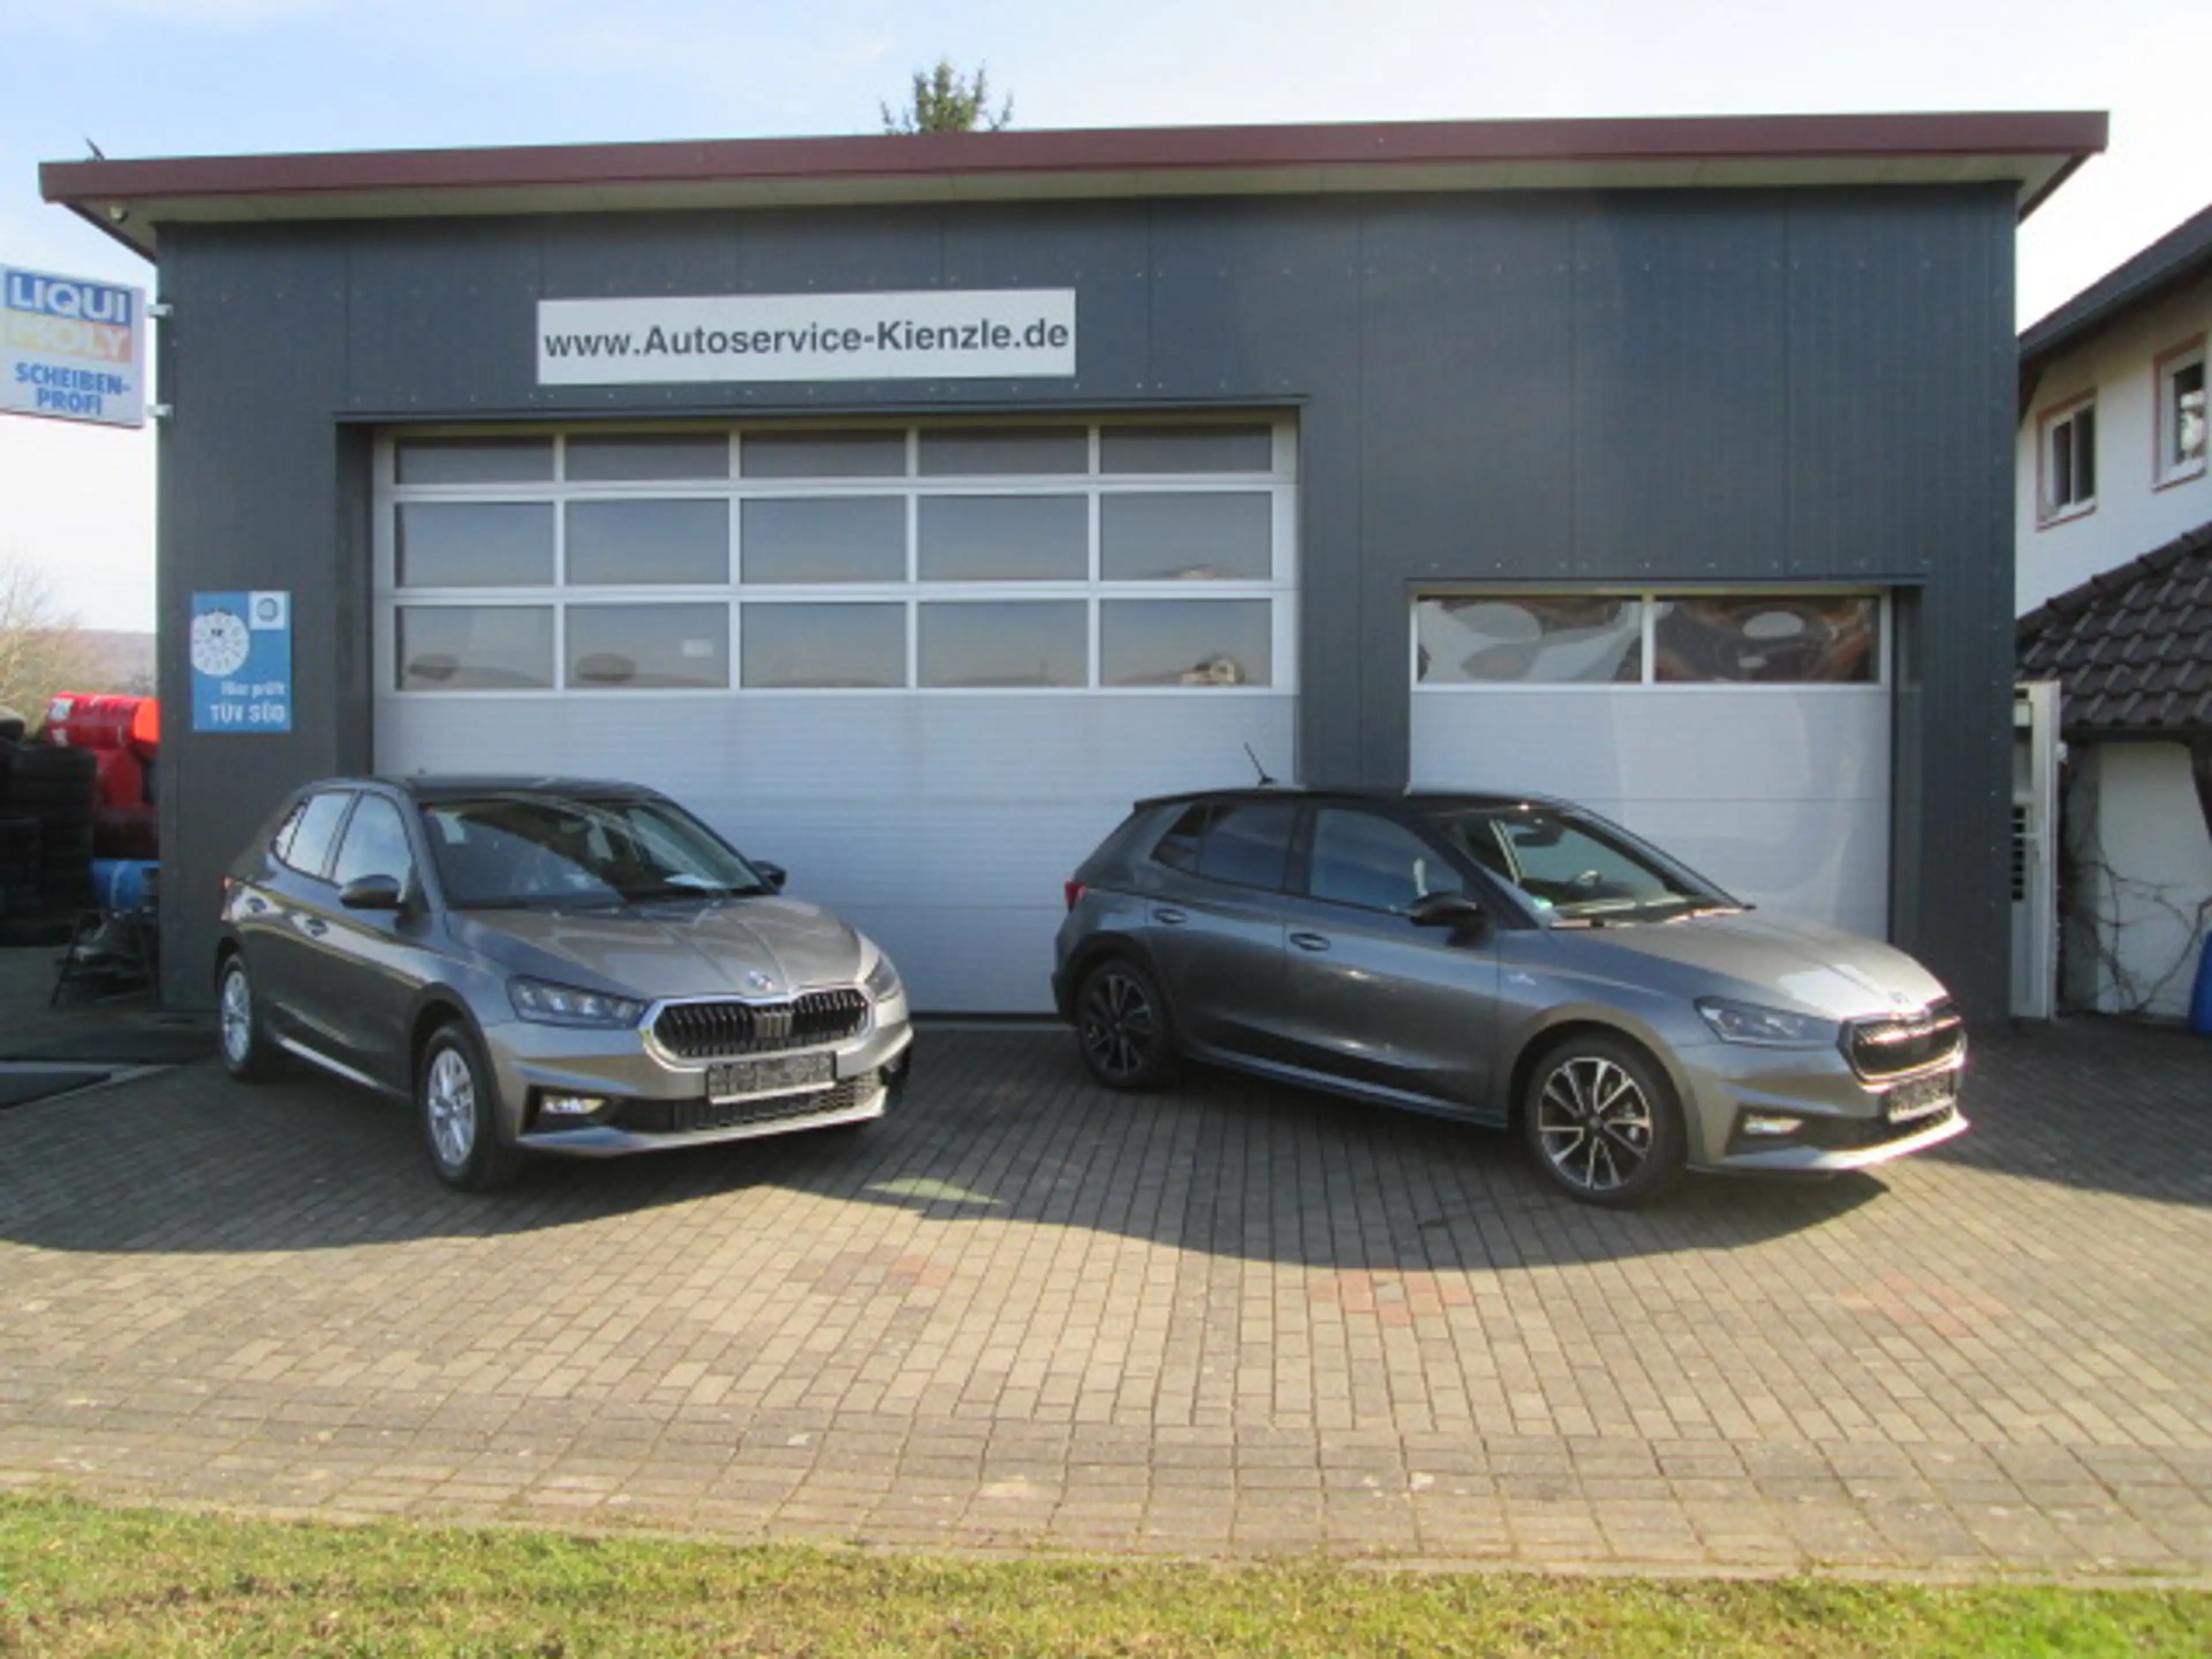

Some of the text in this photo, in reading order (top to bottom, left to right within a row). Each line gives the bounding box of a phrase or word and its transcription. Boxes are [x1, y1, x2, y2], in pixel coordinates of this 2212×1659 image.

[11, 275, 127, 323] LIQUI
[544, 317, 1069, 357] www.Autoservice-Kienzle.de
[14, 362, 131, 395] SCHEIBEN-
[36, 387, 103, 415] PROFI
